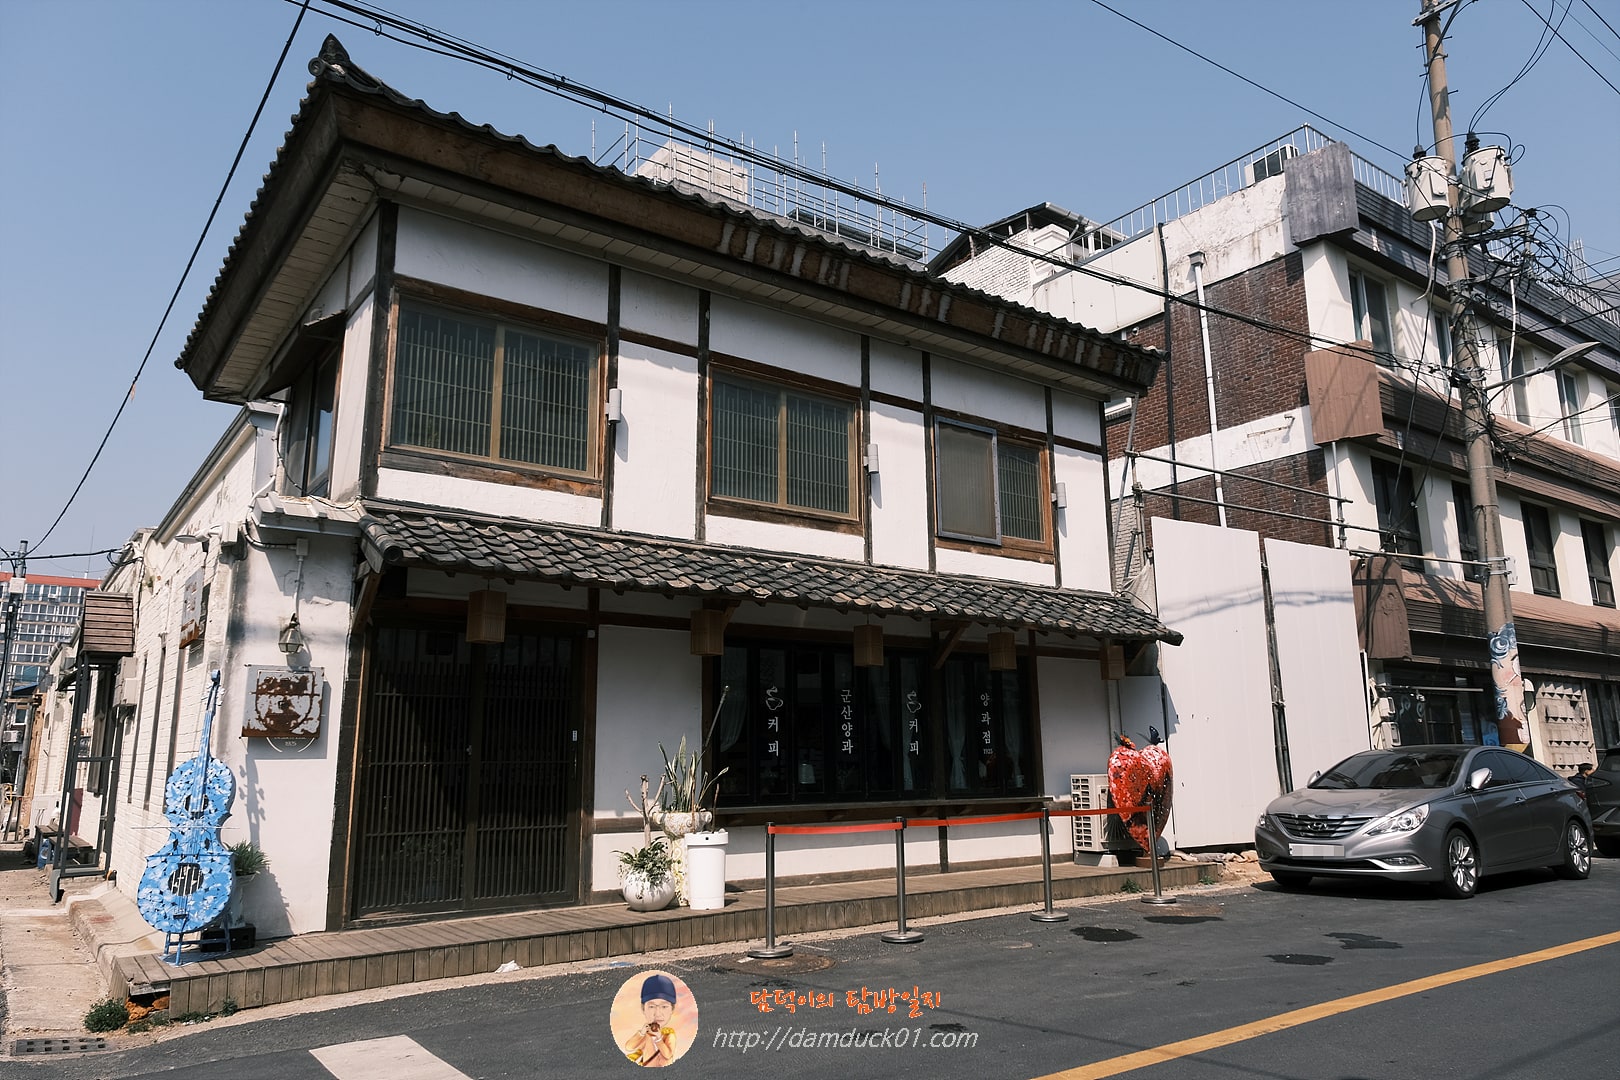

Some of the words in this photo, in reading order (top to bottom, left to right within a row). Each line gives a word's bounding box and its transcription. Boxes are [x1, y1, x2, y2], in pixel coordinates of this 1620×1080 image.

[767, 716, 779, 757] 커피
[840, 689, 854, 755] 군산양과
[908, 718, 919, 756] 커피
[980, 693, 992, 745] 양과점
